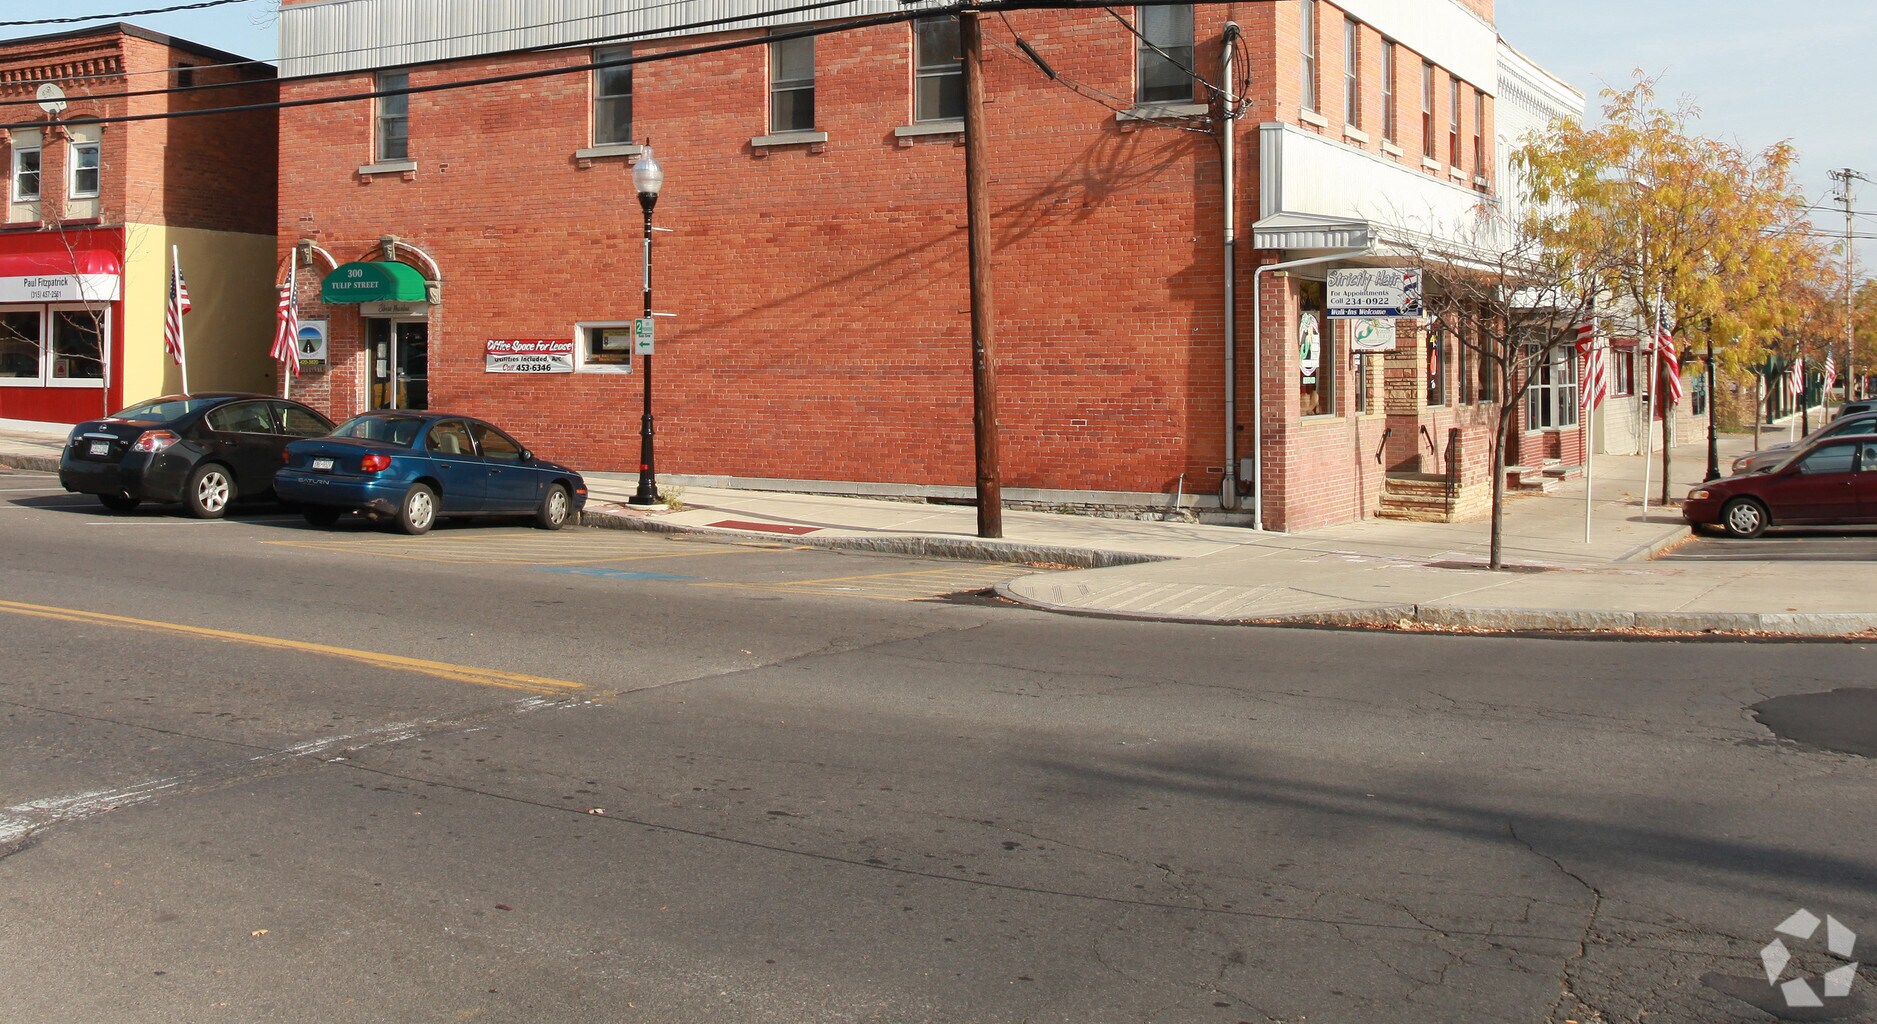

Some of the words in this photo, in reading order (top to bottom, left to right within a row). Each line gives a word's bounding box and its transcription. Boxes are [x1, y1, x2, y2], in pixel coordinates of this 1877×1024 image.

[347, 269, 363, 278] 300
[23, 278, 37, 287] Paul
[37, 277, 68, 289] Fitzpatrick
[353, 281, 379, 289] STREET
[1328, 270, 1372, 291] Strictly
[1374, 270, 1399, 287] Hair
[1345, 297, 1389, 305] 234-0922
[636, 321, 643, 333] 2
[487, 340, 511, 351] Office
[511, 340, 535, 352] Space
[535, 341, 550, 351] For
